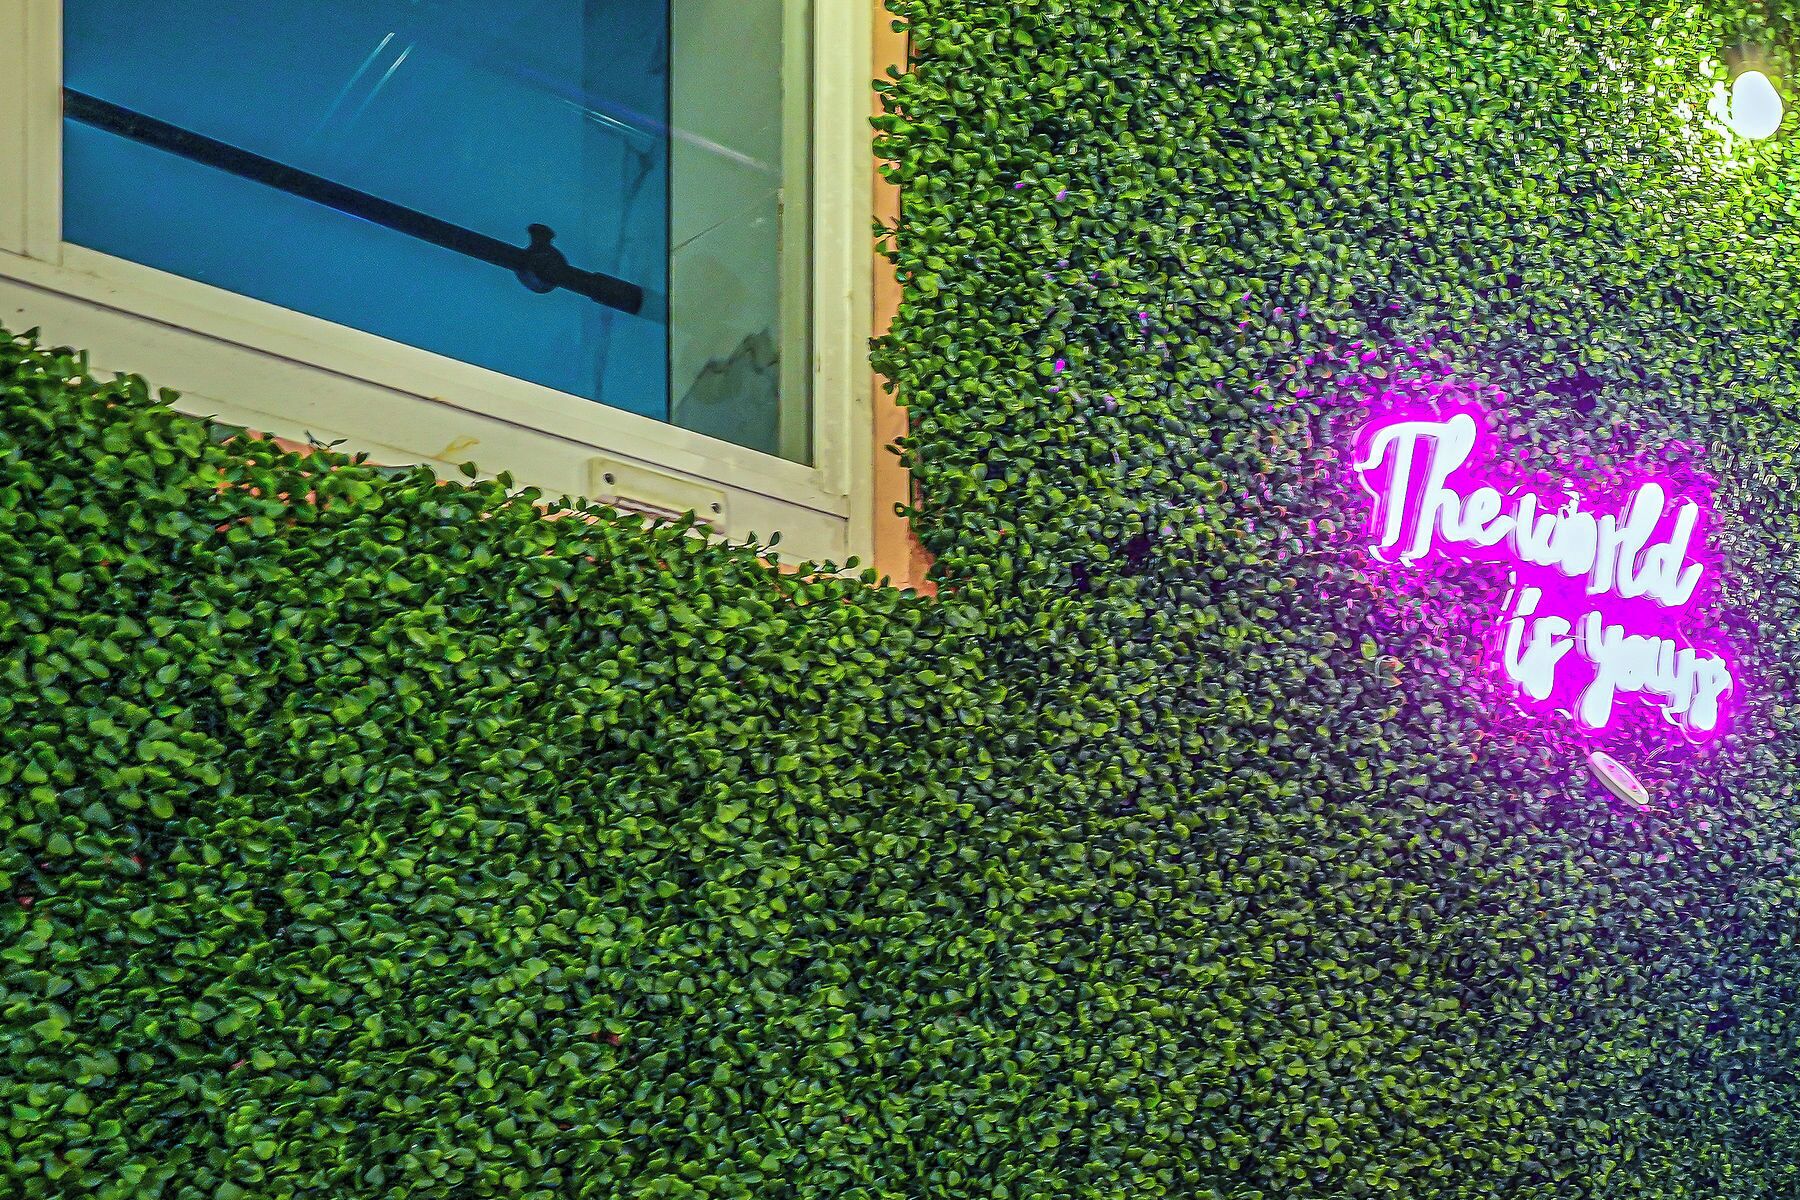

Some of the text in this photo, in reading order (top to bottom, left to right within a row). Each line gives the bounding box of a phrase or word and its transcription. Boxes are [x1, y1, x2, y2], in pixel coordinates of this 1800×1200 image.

[1353, 414, 1704, 606] The world
[1502, 587, 1733, 732] is yours
